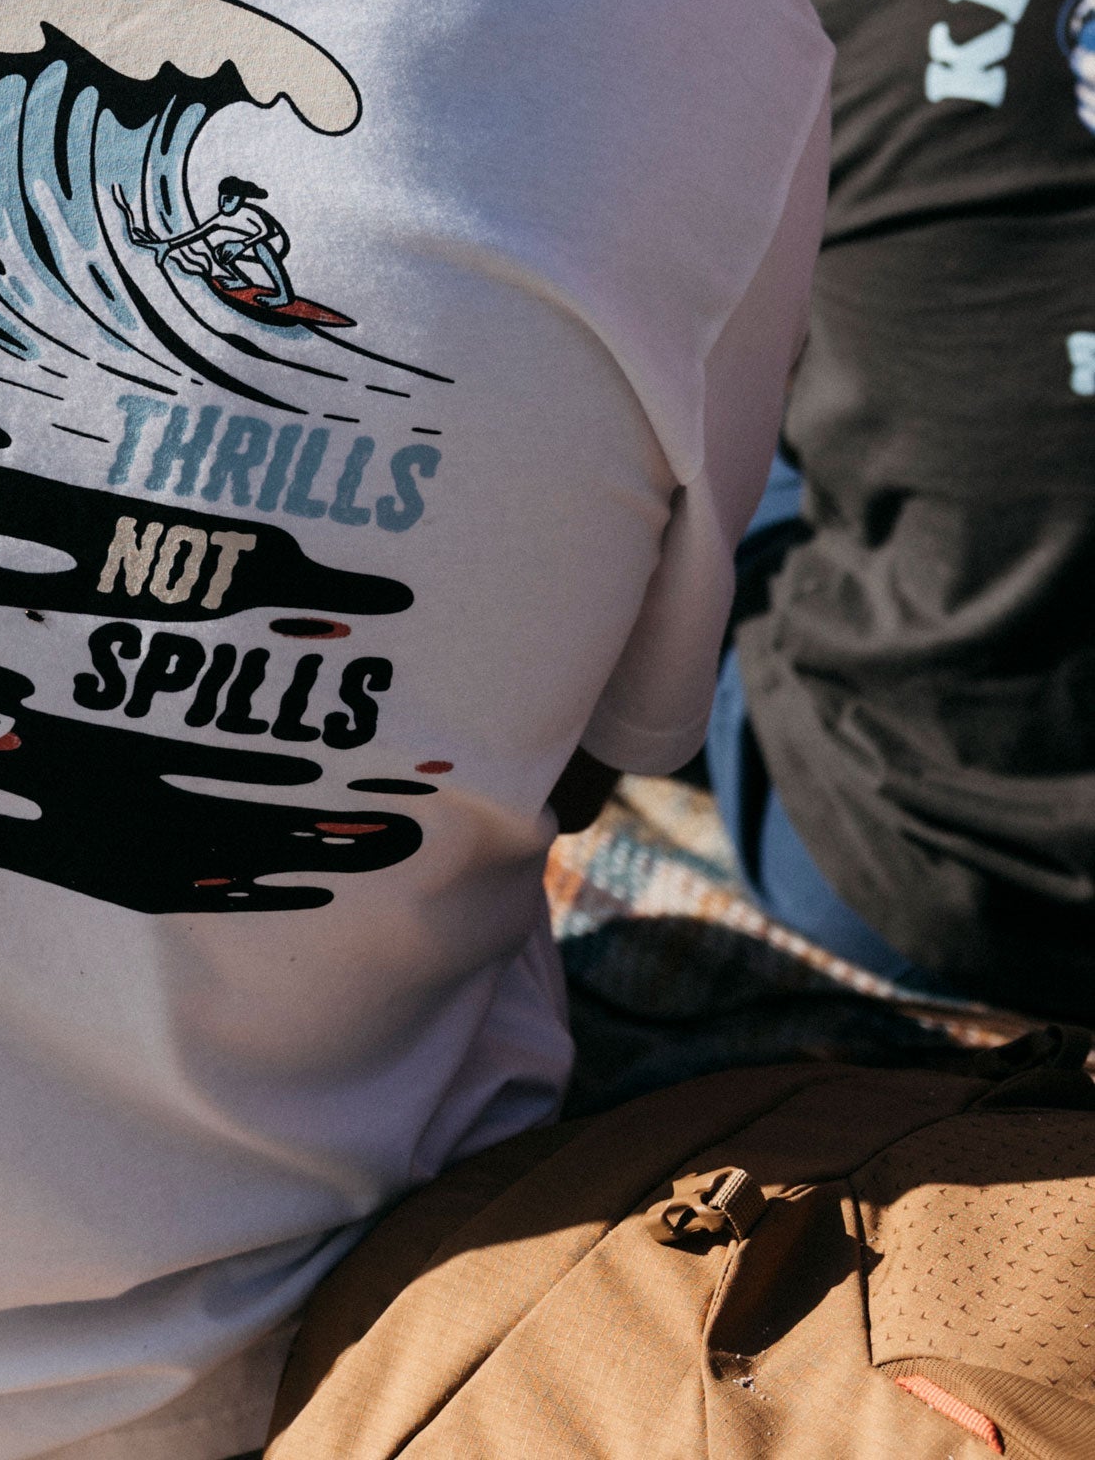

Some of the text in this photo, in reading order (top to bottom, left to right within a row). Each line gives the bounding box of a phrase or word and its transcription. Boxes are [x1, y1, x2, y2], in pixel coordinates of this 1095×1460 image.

[108, 394, 442, 532] THRILLS
[96, 516, 257, 610] NOT
[73, 622, 393, 750] SPILLS
